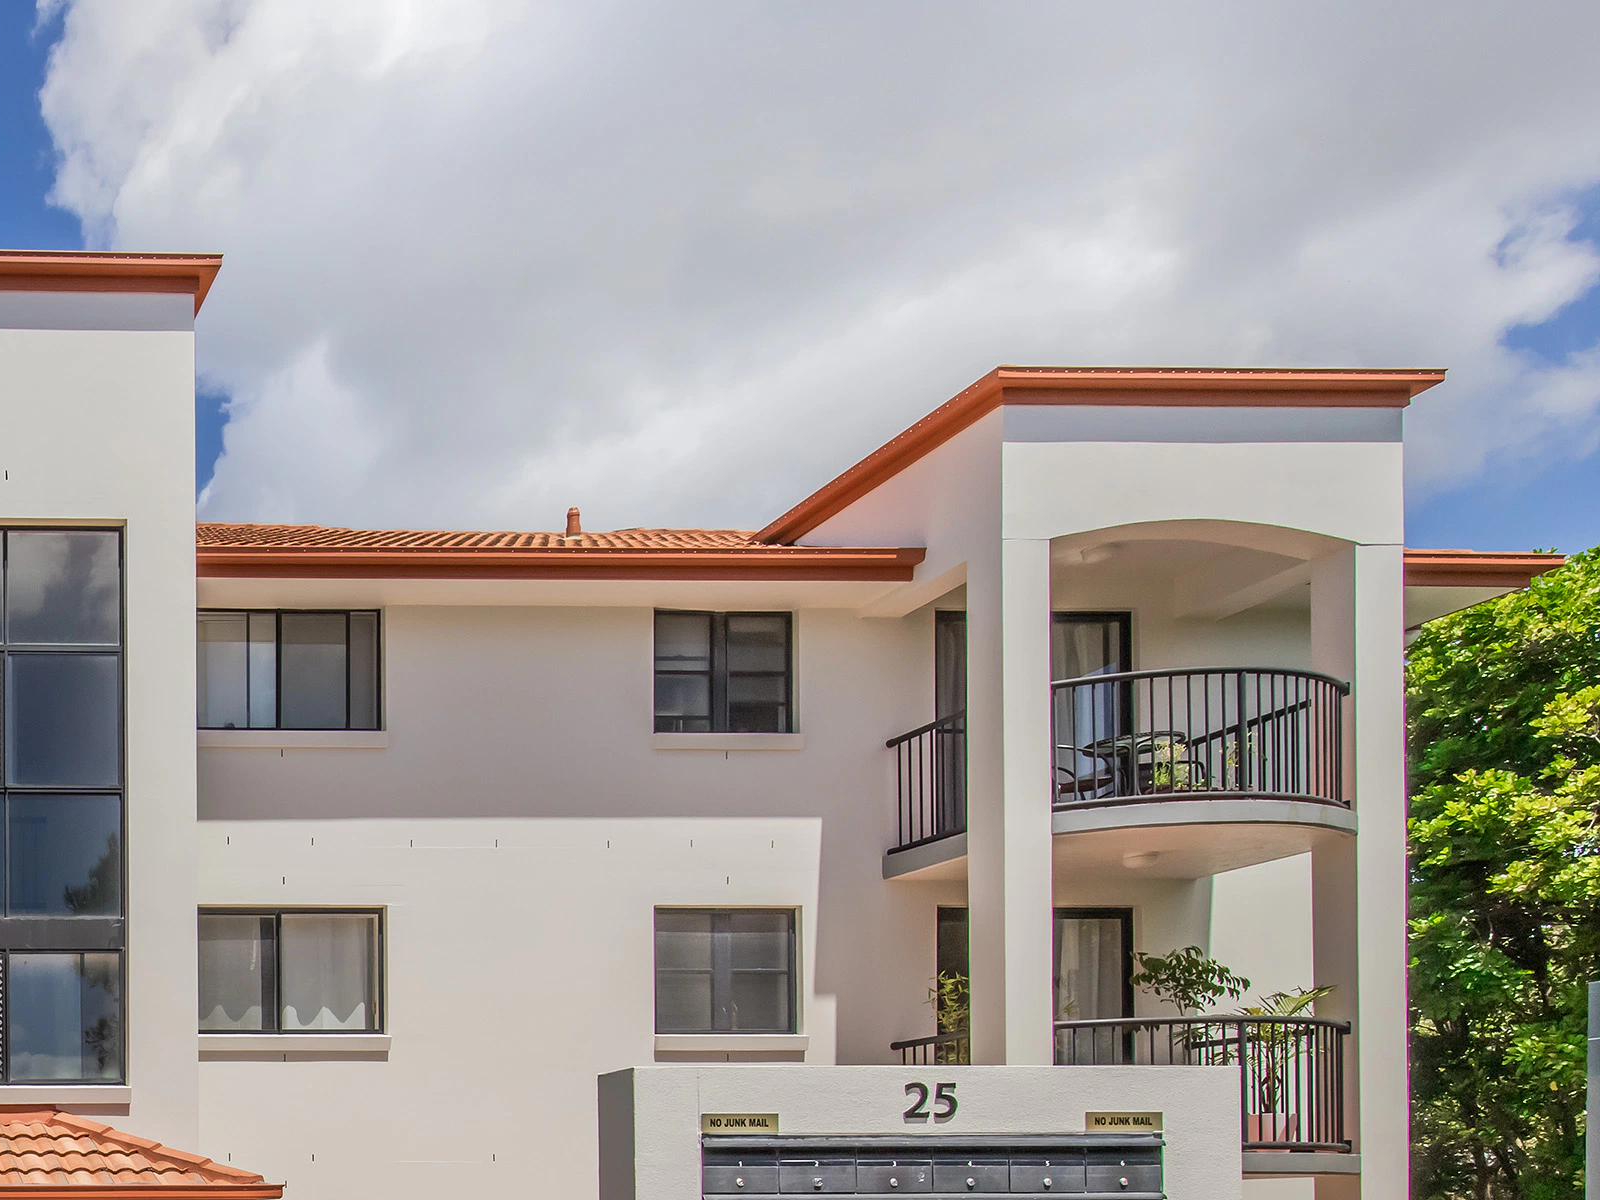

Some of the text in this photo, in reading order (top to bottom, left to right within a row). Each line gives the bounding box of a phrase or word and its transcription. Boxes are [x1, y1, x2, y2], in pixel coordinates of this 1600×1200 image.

[903, 1082, 958, 1123] 25
[709, 1118, 769, 1127] NO JUNK MAIL
[1094, 1116, 1153, 1126] NO JUNK MAIL
